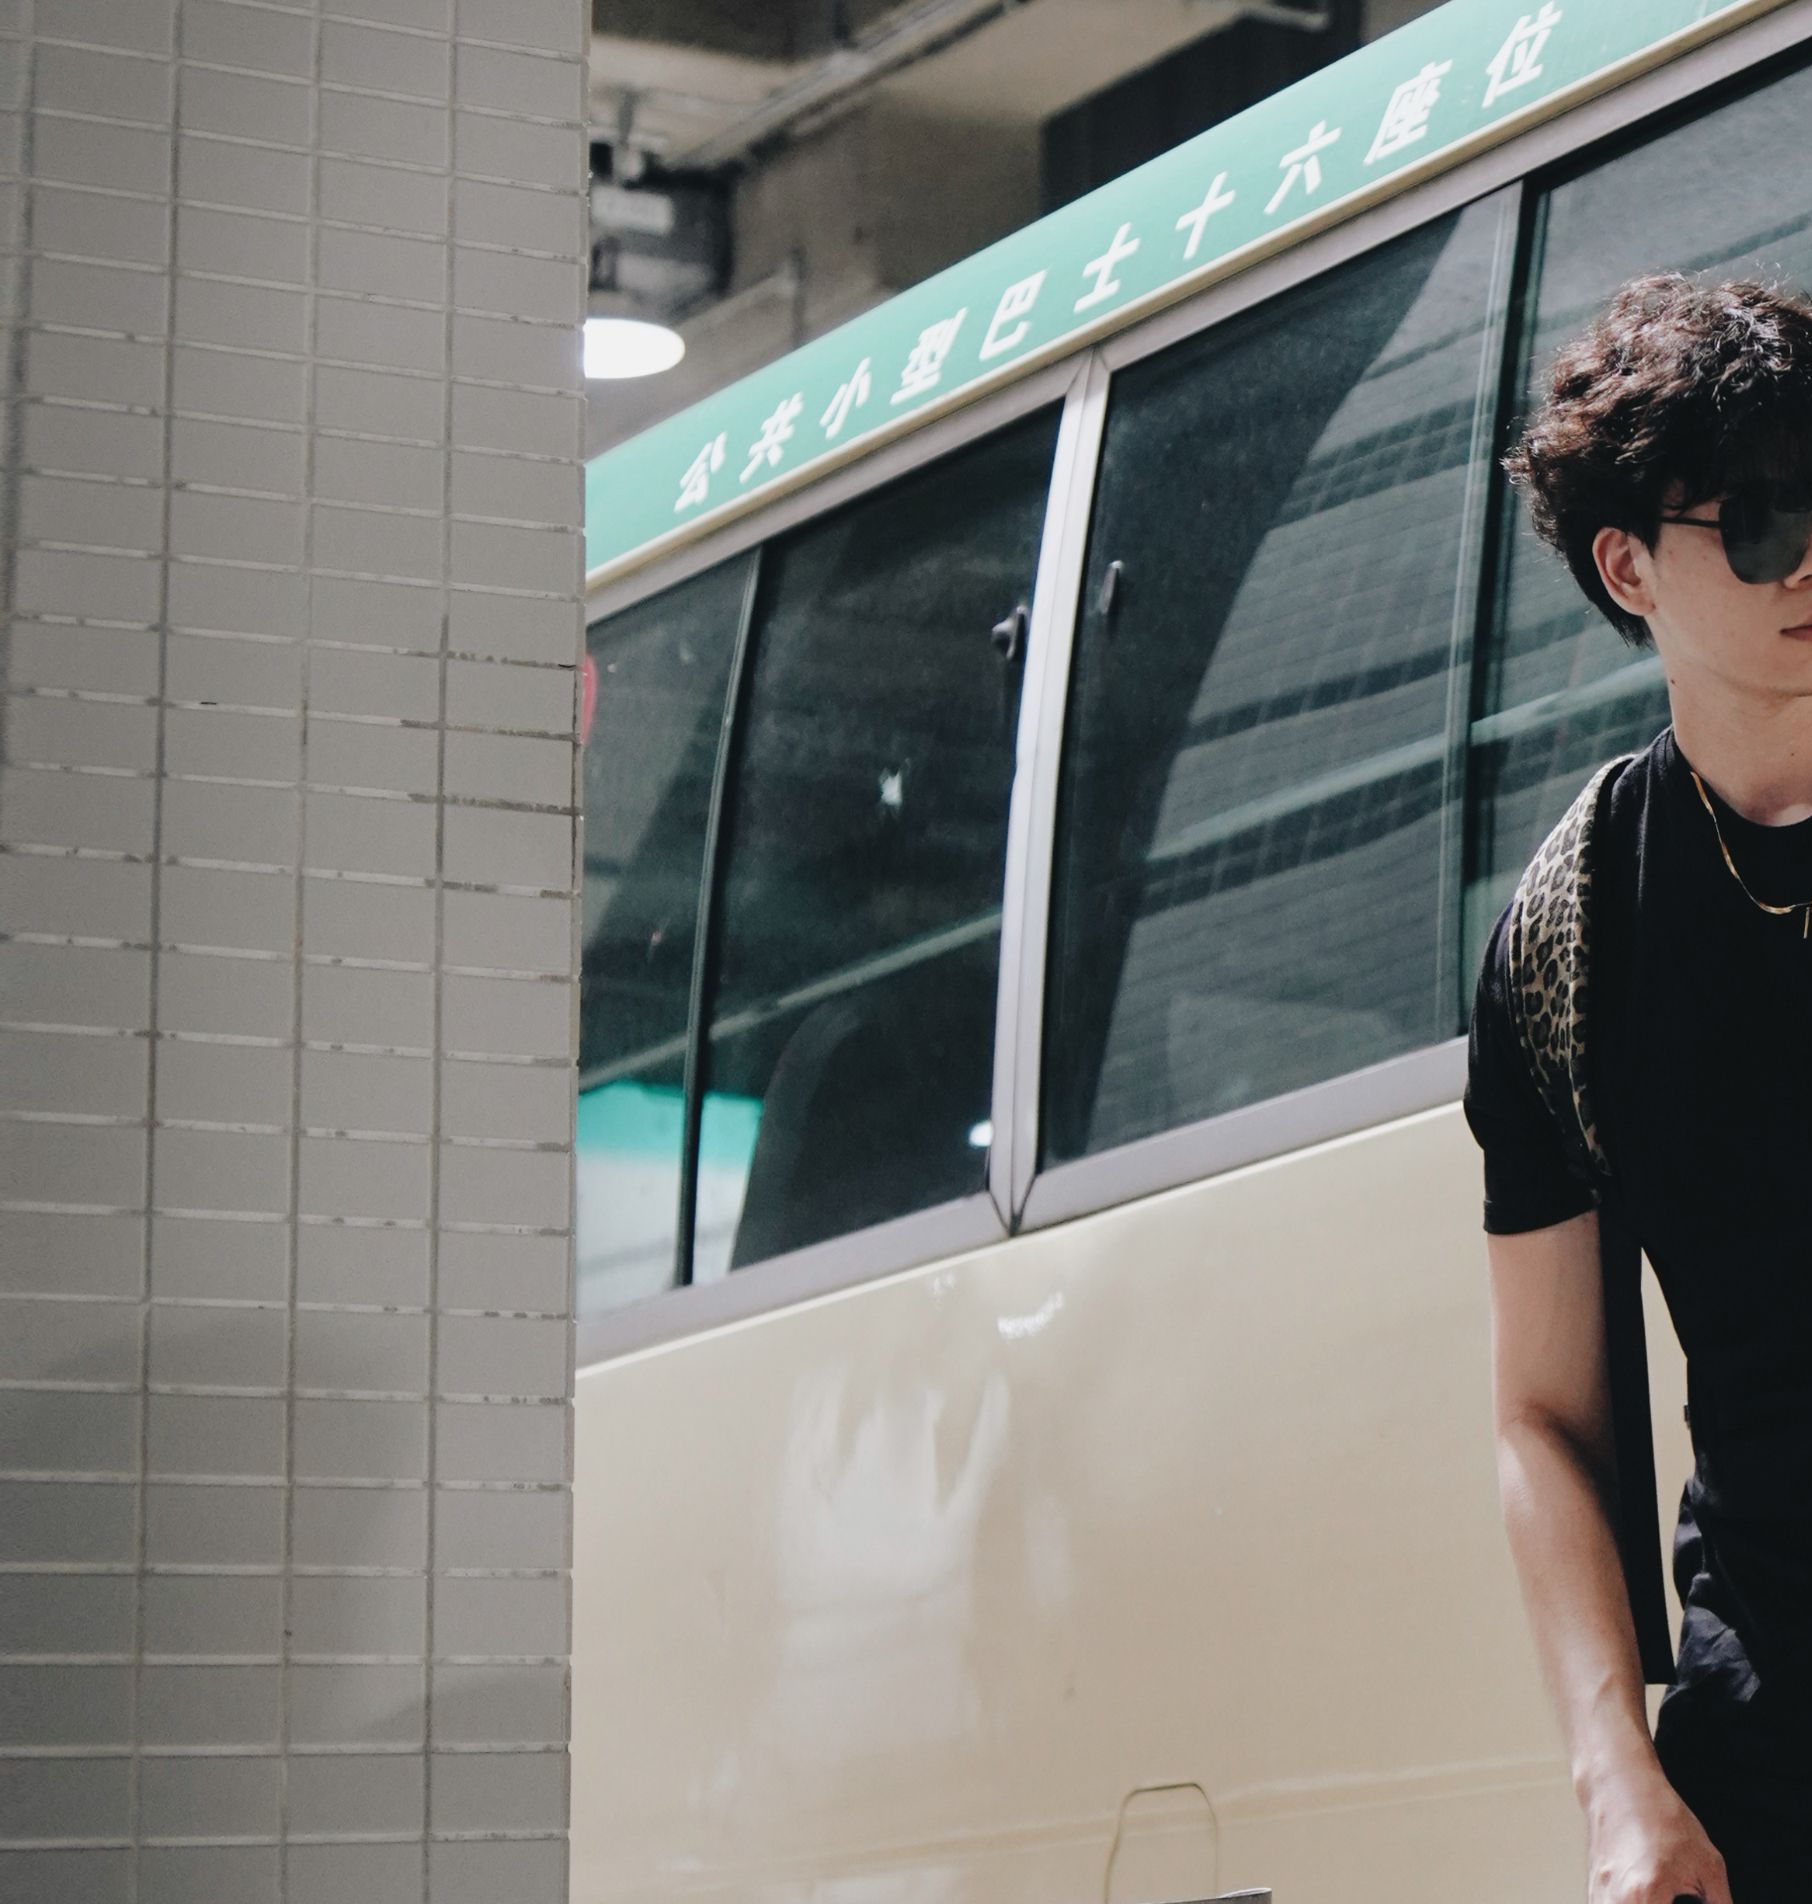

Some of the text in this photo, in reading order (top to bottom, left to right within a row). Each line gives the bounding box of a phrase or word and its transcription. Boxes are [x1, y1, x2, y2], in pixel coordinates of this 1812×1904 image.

[673, 0, 1564, 514] 公共小型巴士十六座位
